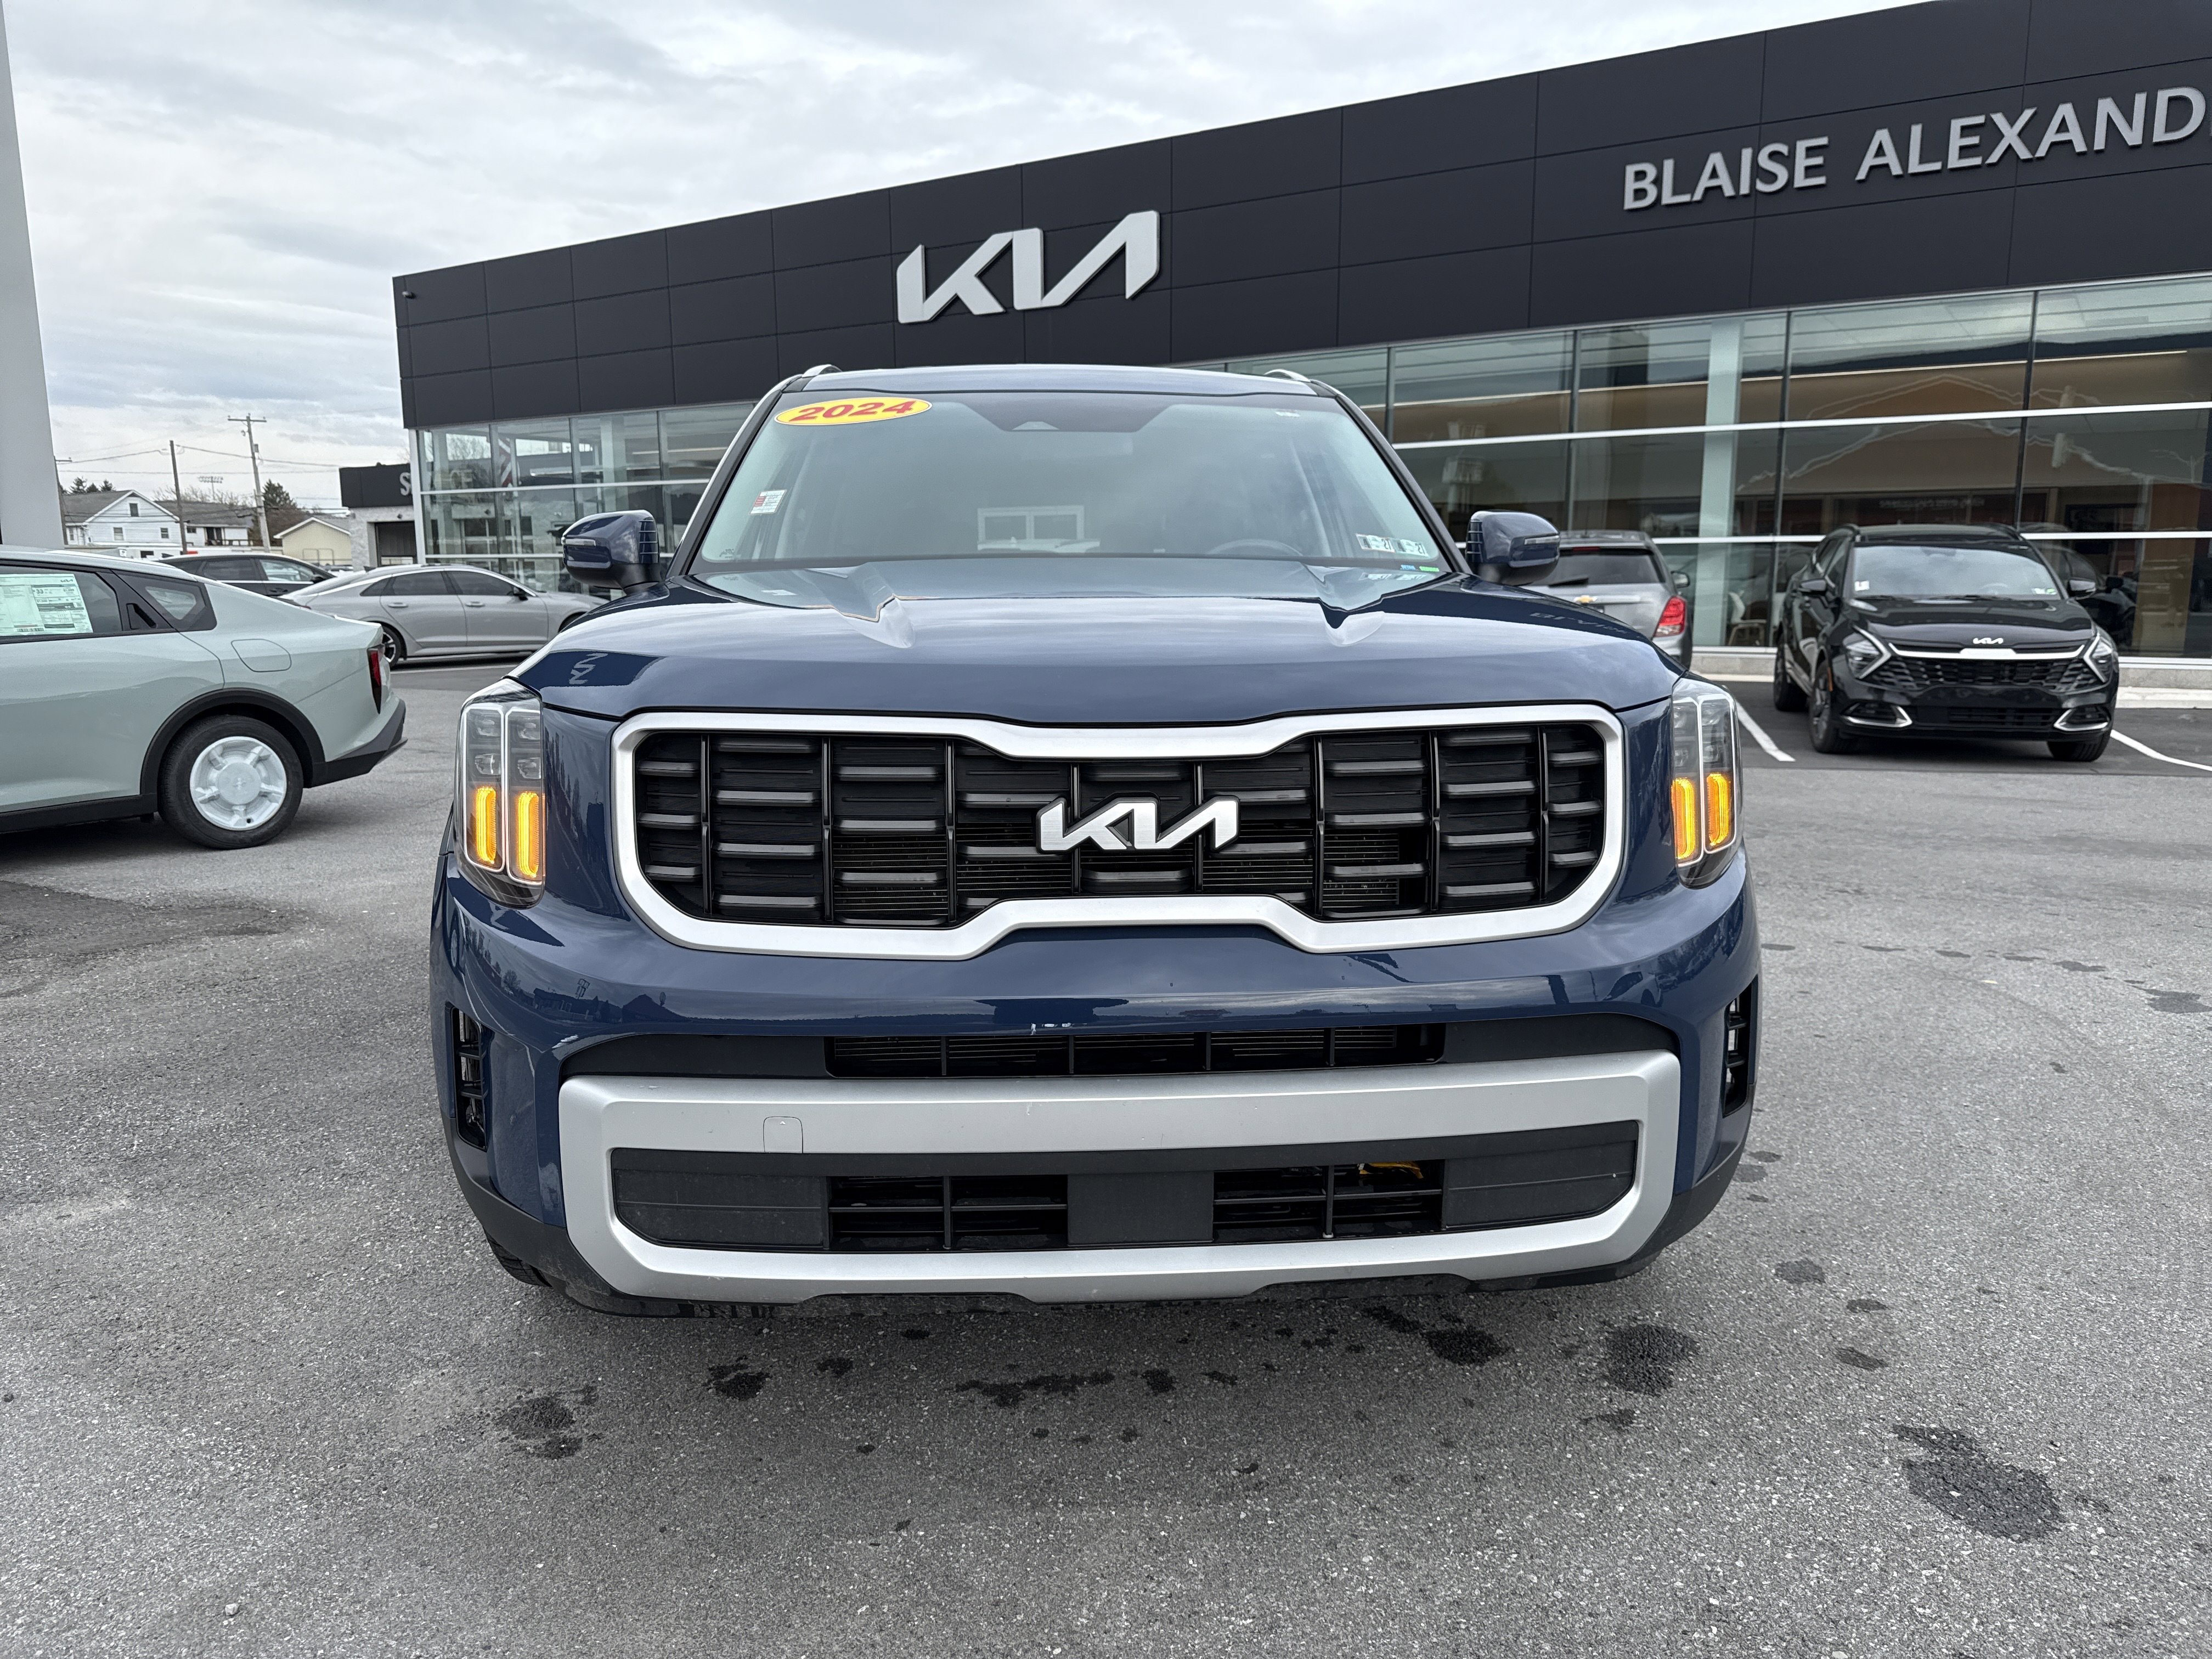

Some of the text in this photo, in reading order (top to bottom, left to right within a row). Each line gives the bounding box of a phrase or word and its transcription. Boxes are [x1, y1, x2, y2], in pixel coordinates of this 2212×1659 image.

[1623, 86, 2212, 211] BLAISE ALEXAND
[896, 210, 1160, 324] KIA
[789, 400, 917, 422] 2024
[1037, 797, 1239, 852] KIA
